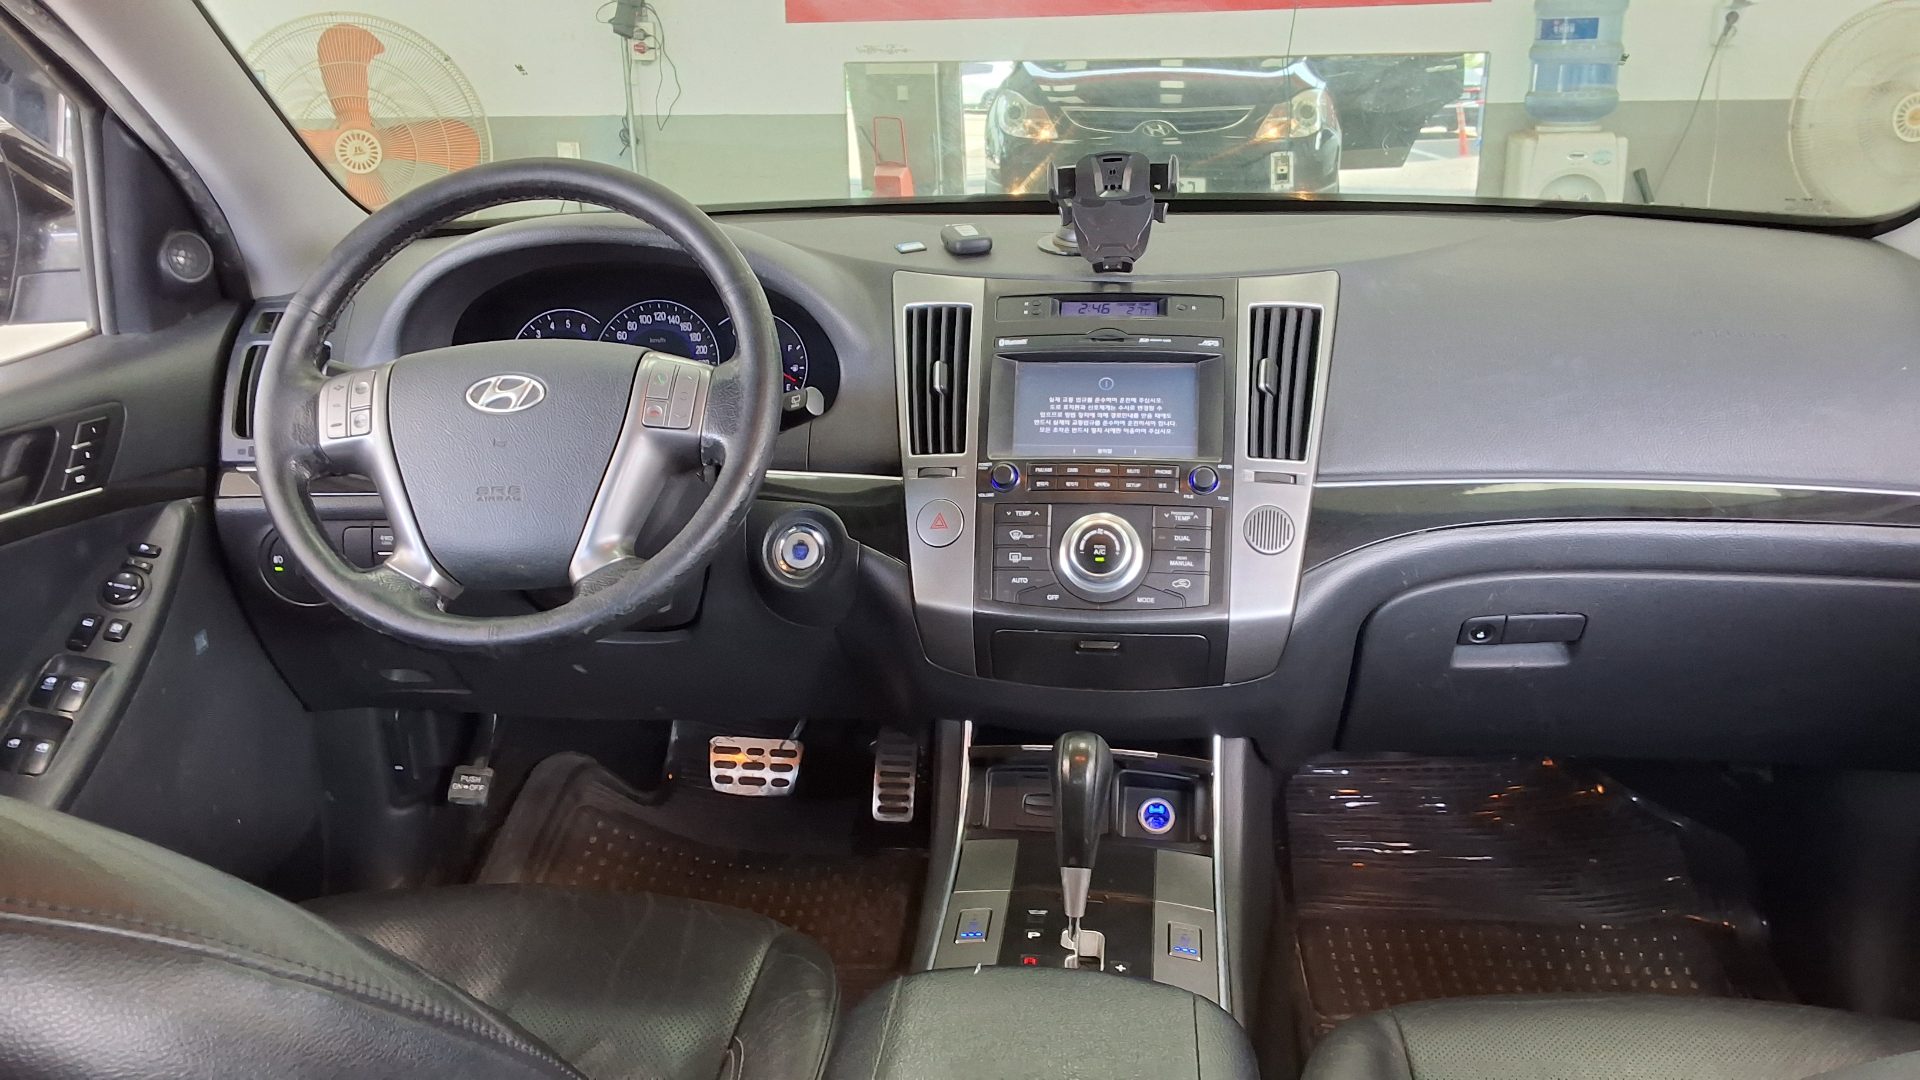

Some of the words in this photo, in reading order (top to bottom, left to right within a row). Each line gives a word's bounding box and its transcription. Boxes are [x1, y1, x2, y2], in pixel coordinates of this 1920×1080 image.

[1078, 303, 1110, 314] 2:46
[639, 314, 653, 325] 100
[653, 311, 667, 321] 120
[667, 314, 681, 325] 140
[550, 321, 555, 331] 4
[565, 319, 571, 329] 5
[580, 323, 587, 333] 6
[627, 321, 638, 331] 80
[680, 322, 693, 332] 160
[535, 329, 541, 339] 3
[616, 331, 628, 341] 60
[689, 332, 702, 342] 180
[695, 345, 708, 355] 200
[461, 774, 482, 783] PUSH
